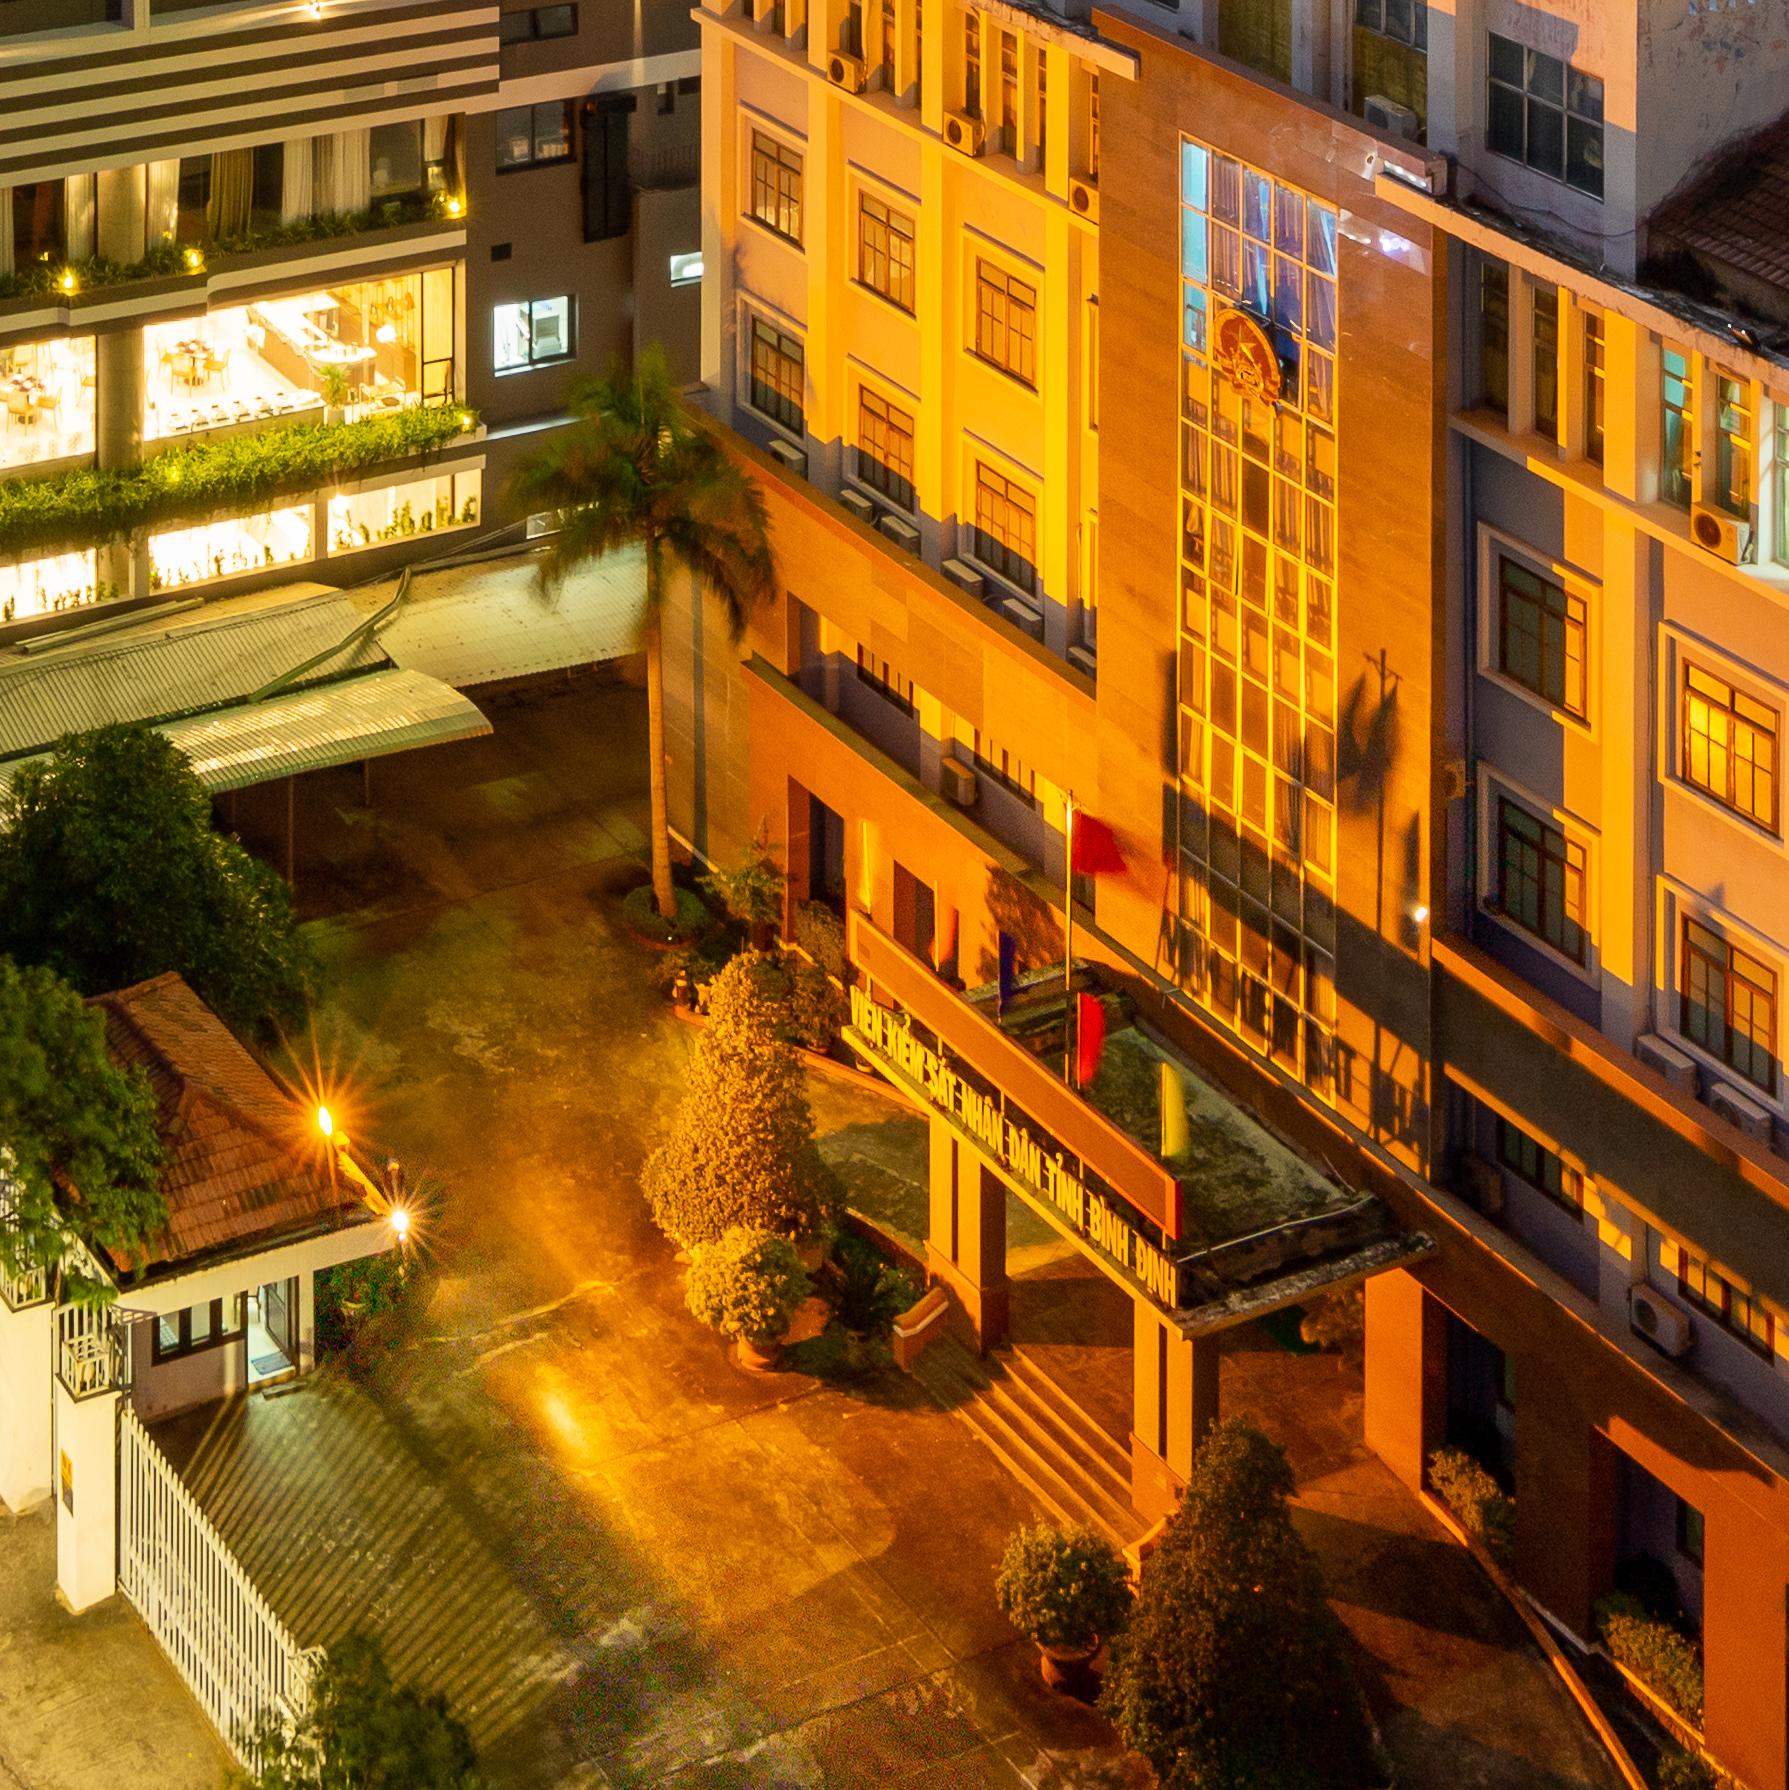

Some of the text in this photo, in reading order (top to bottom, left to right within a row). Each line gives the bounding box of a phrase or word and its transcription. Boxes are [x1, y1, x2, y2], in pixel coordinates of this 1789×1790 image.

[849, 985, 1176, 1309] VIỆN KIỂM SÁT NHÂN DÂN TỈNH BÌNH ĐỊNH
